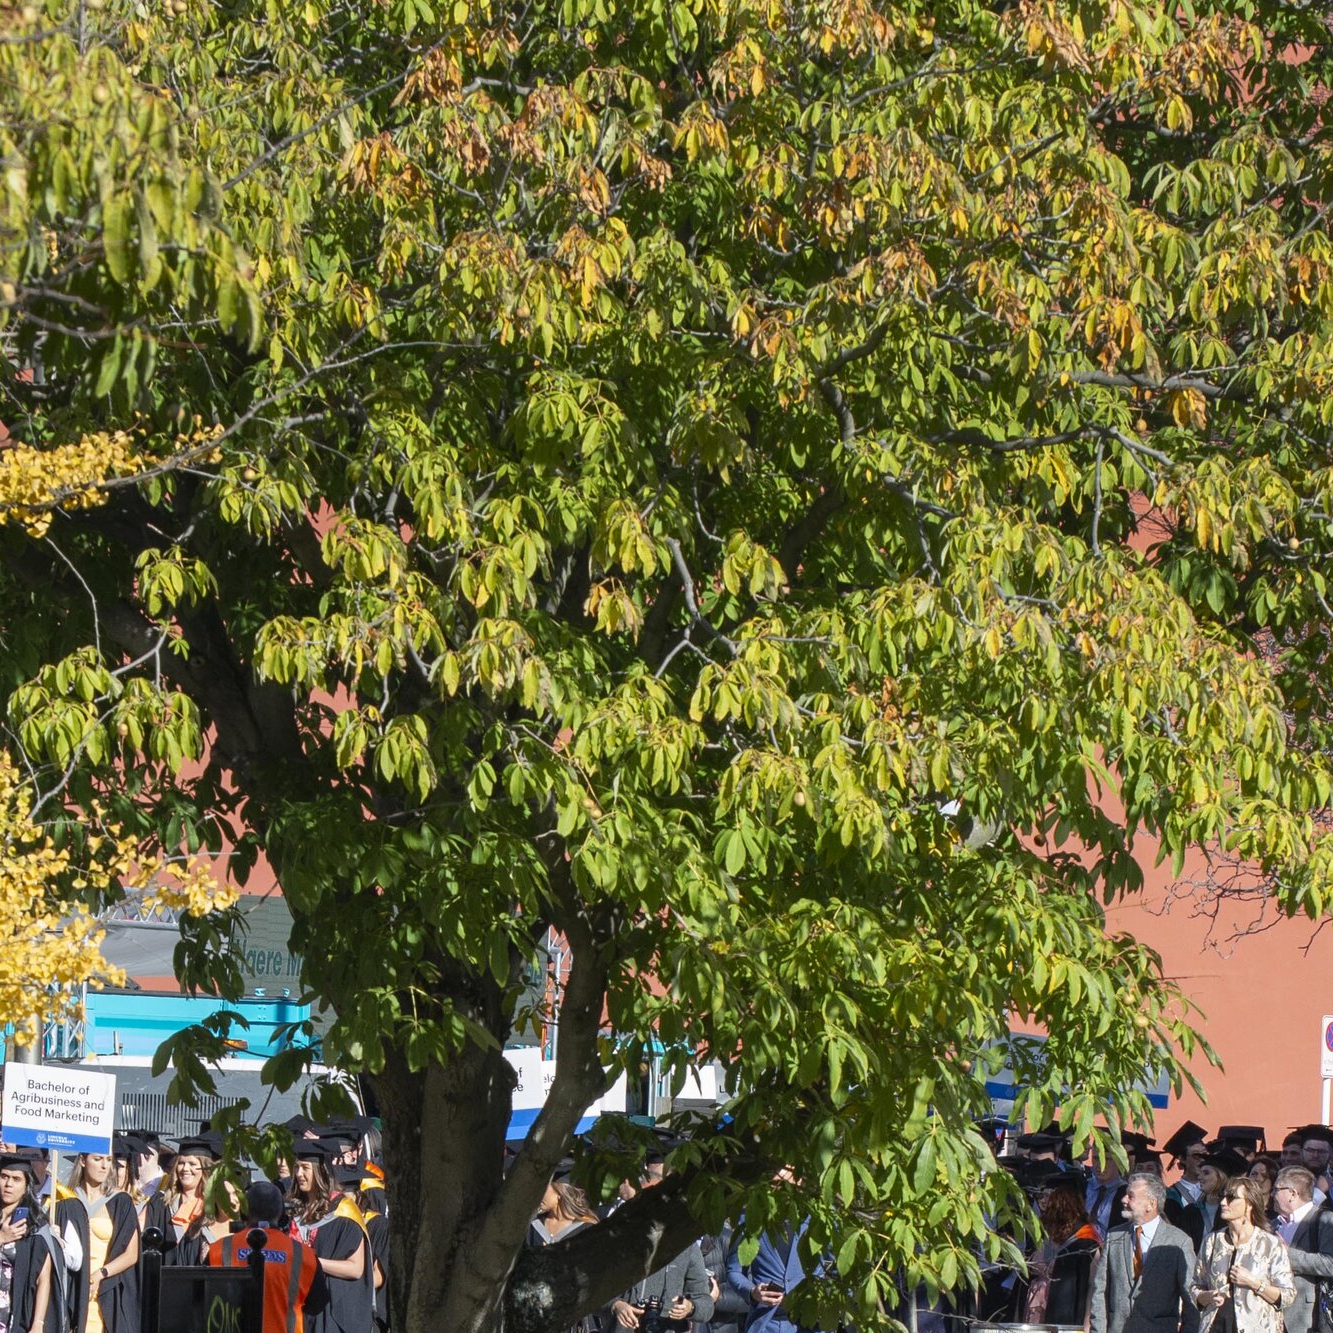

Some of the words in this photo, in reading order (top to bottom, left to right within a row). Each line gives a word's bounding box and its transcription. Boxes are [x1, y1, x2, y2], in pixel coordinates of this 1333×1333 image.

[28, 1079, 75, 1094] Bachelor
[78, 1085, 90, 1095] of
[11, 1091, 82, 1109] Agribusiness
[84, 1100, 105, 1111] and
[15, 1105, 42, 1117] Food
[44, 1108, 100, 1126] Marketing
